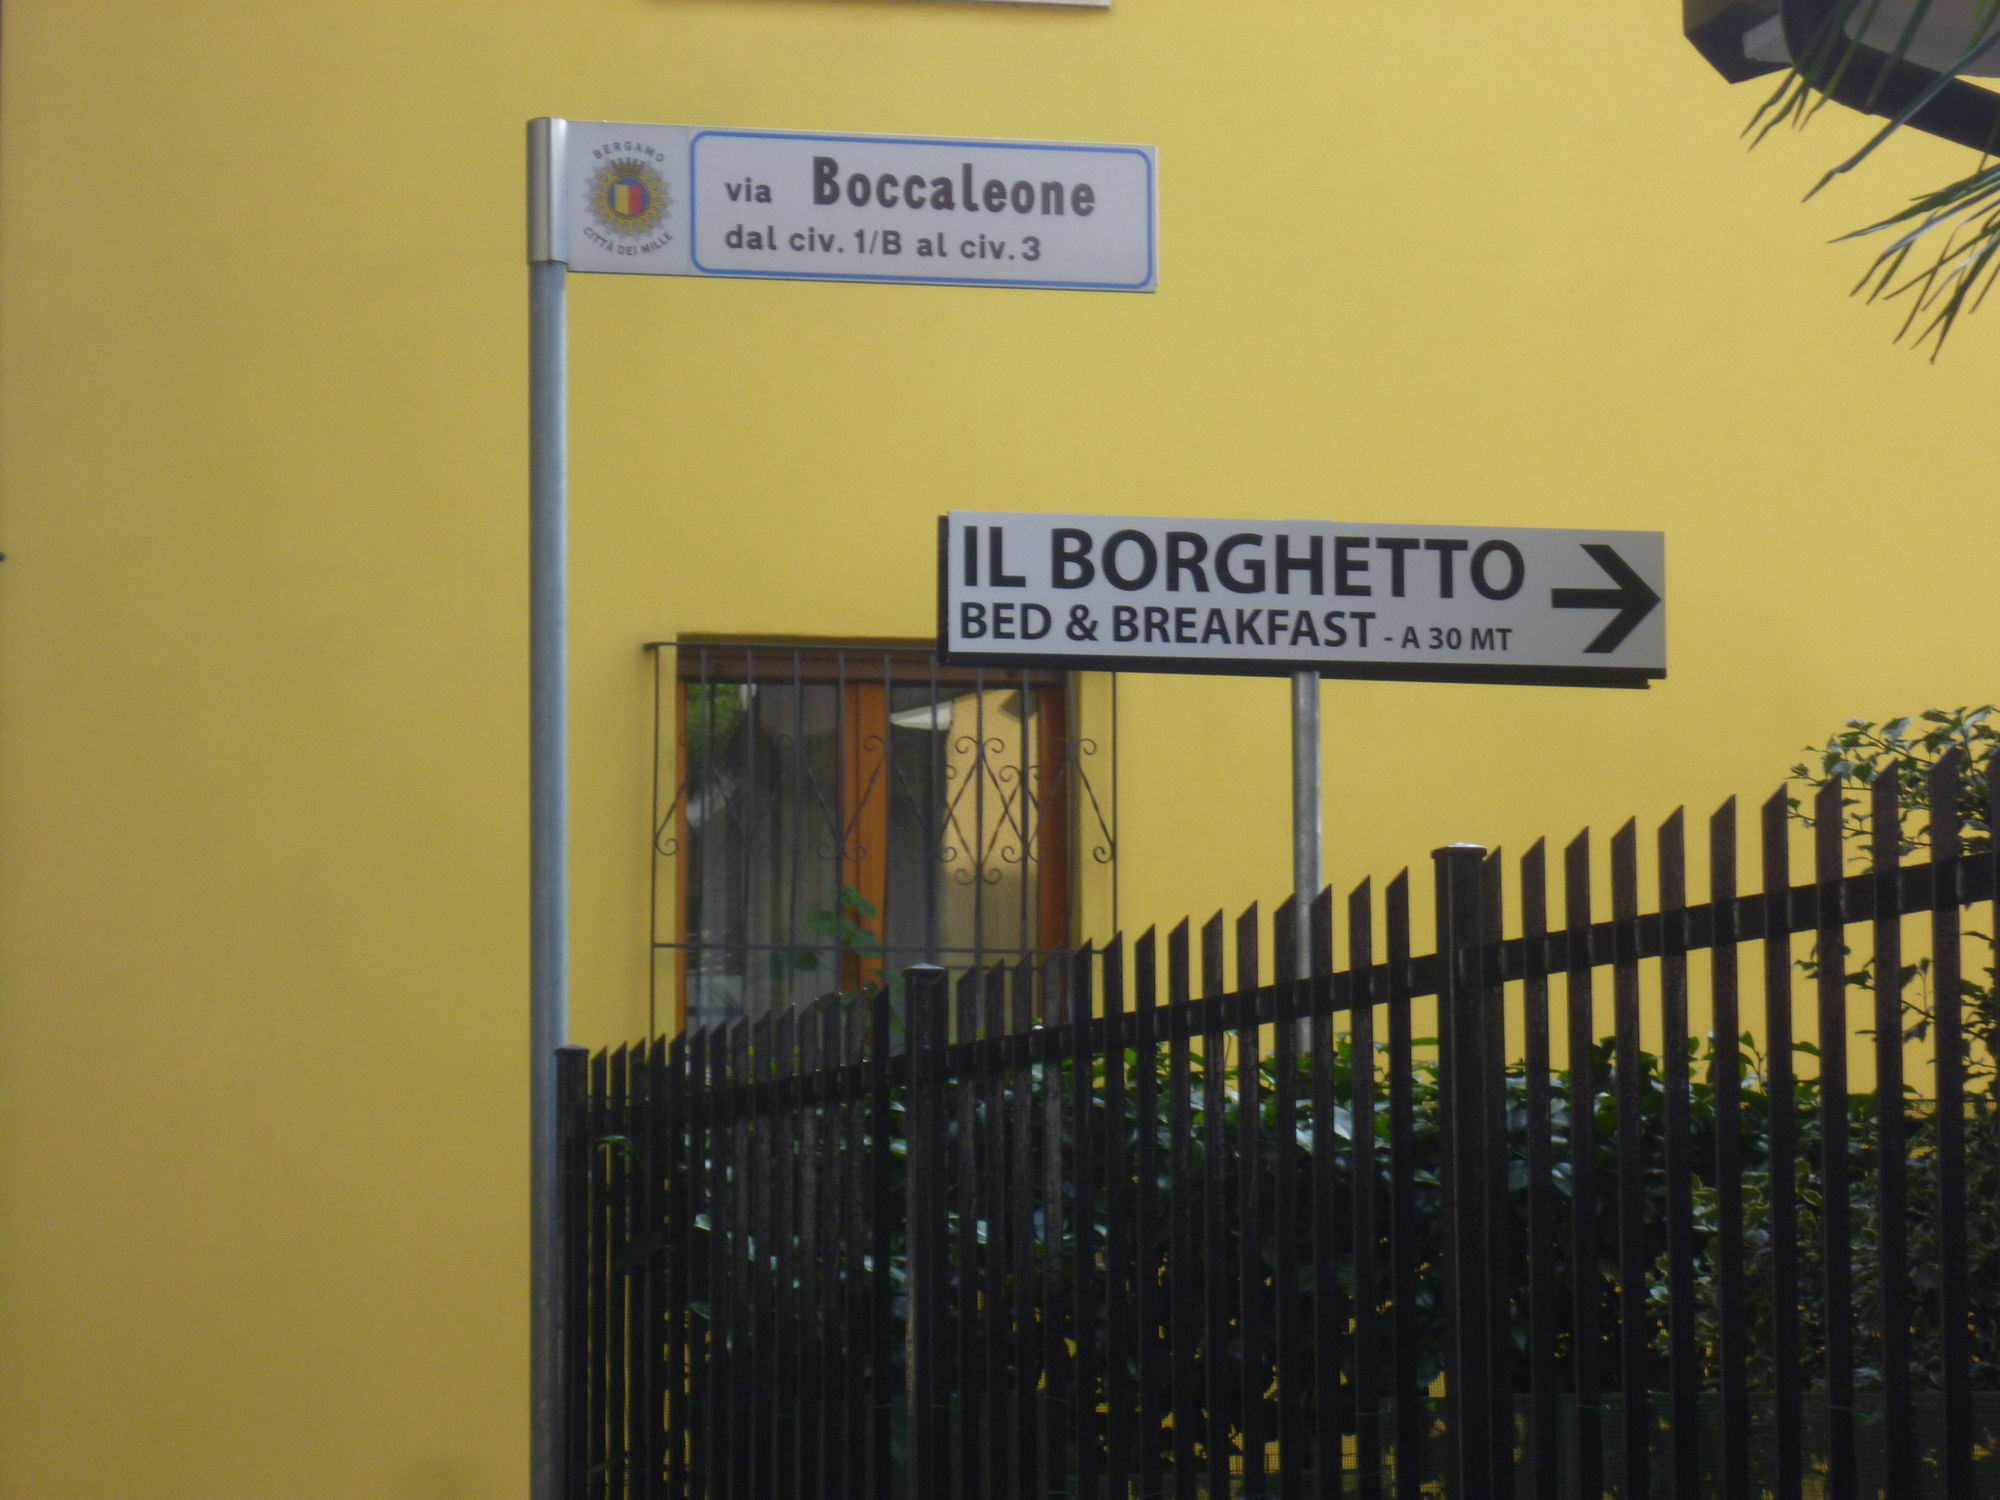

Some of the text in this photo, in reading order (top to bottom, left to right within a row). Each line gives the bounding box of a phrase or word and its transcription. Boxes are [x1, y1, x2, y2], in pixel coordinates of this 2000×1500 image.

[592, 141, 665, 163] BERGAMO
[725, 156, 1095, 217] via Boccaleone
[617, 245, 638, 256] DEI
[640, 231, 674, 255] MILLE
[725, 225, 777, 251] dal
[854, 229, 902, 256] 1/B
[916, 232, 947, 258] al
[964, 525, 1525, 601] IL BORGHETTO
[961, 601, 1052, 640] BED
[1065, 604, 1099, 642] &
[1113, 605, 1376, 648] BREAKFAST
[1401, 626, 1421, 649] A
[1428, 627, 1462, 650] 30
[1470, 627, 1513, 651] MT
